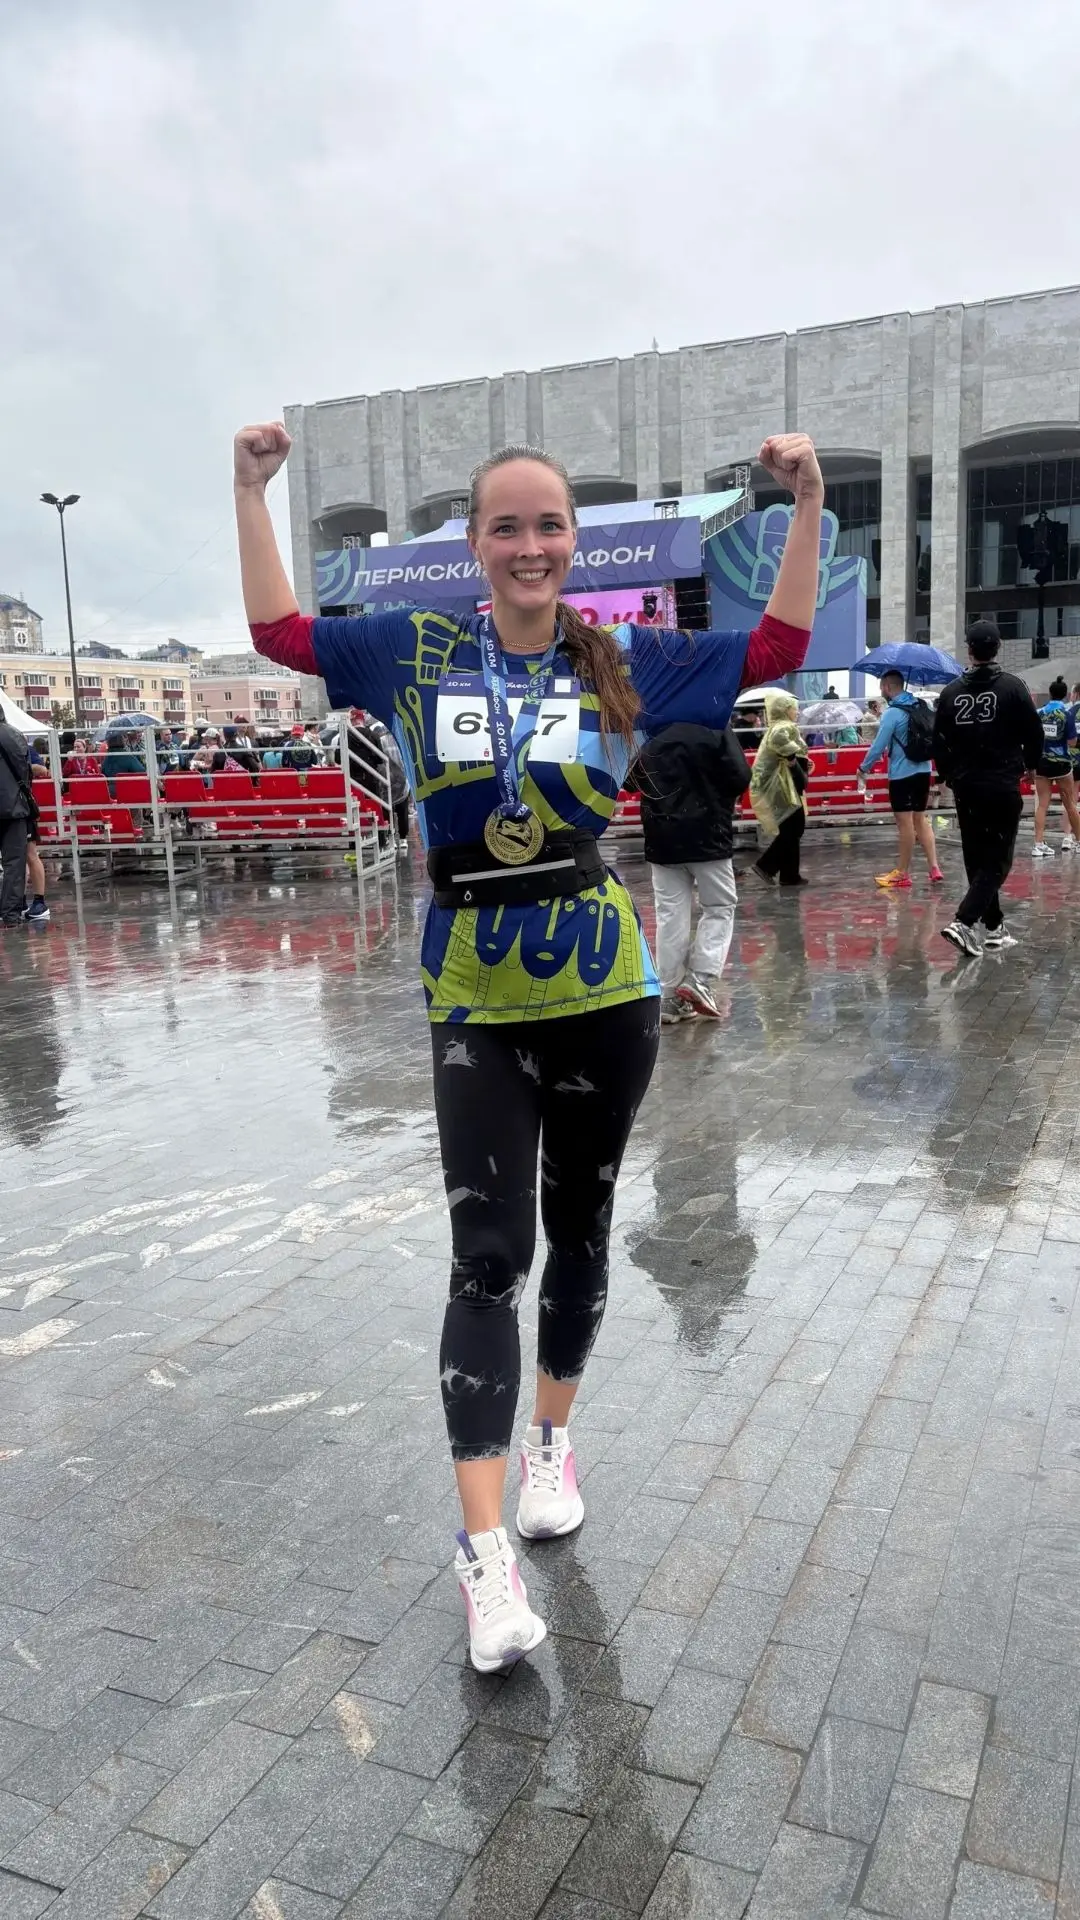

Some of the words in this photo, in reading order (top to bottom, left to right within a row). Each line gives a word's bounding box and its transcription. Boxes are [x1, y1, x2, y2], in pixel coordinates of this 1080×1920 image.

[353, 560, 481, 587] ПЕРМСКИ
[570, 544, 656, 568] АФОН
[453, 711, 567, 736] 67
[954, 691, 997, 725] 23
[496, 721, 505, 735] 10
[502, 769, 515, 803] МАРАФ
